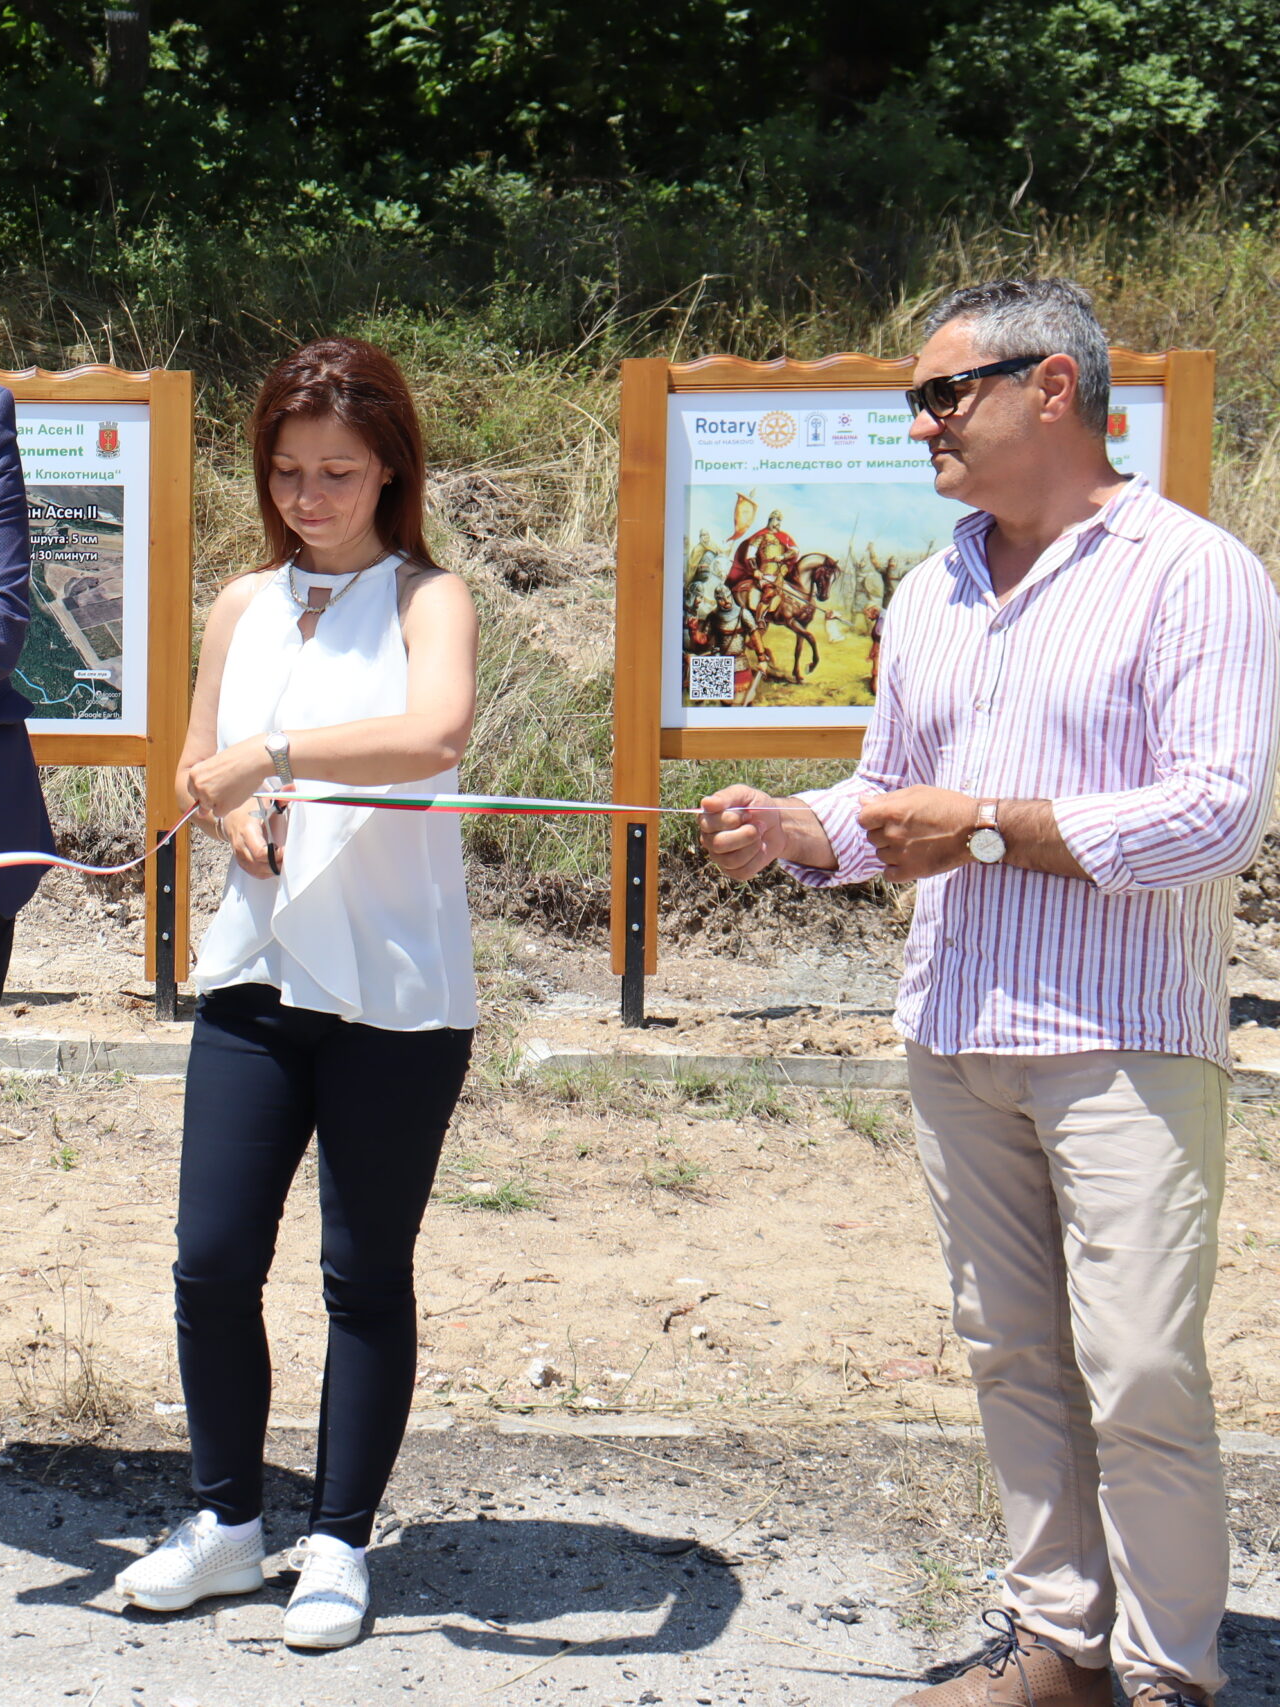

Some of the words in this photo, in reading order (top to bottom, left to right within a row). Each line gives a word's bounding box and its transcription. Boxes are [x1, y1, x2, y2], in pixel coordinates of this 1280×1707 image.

[38, 424, 72, 436] Асен
[695, 417, 757, 437] Rotary
[867, 433, 902, 445] Tsar
[19, 446, 84, 457] onument
[694, 459, 748, 472] Проект:
[847, 460, 862, 469] от
[866, 460, 933, 469] миналото
[45, 505, 82, 519] Асен
[30, 535, 69, 545] шрута:
[72, 533, 79, 544] 5
[81, 535, 98, 544] км
[38, 550, 52, 560] 30
[54, 552, 98, 563] минути
